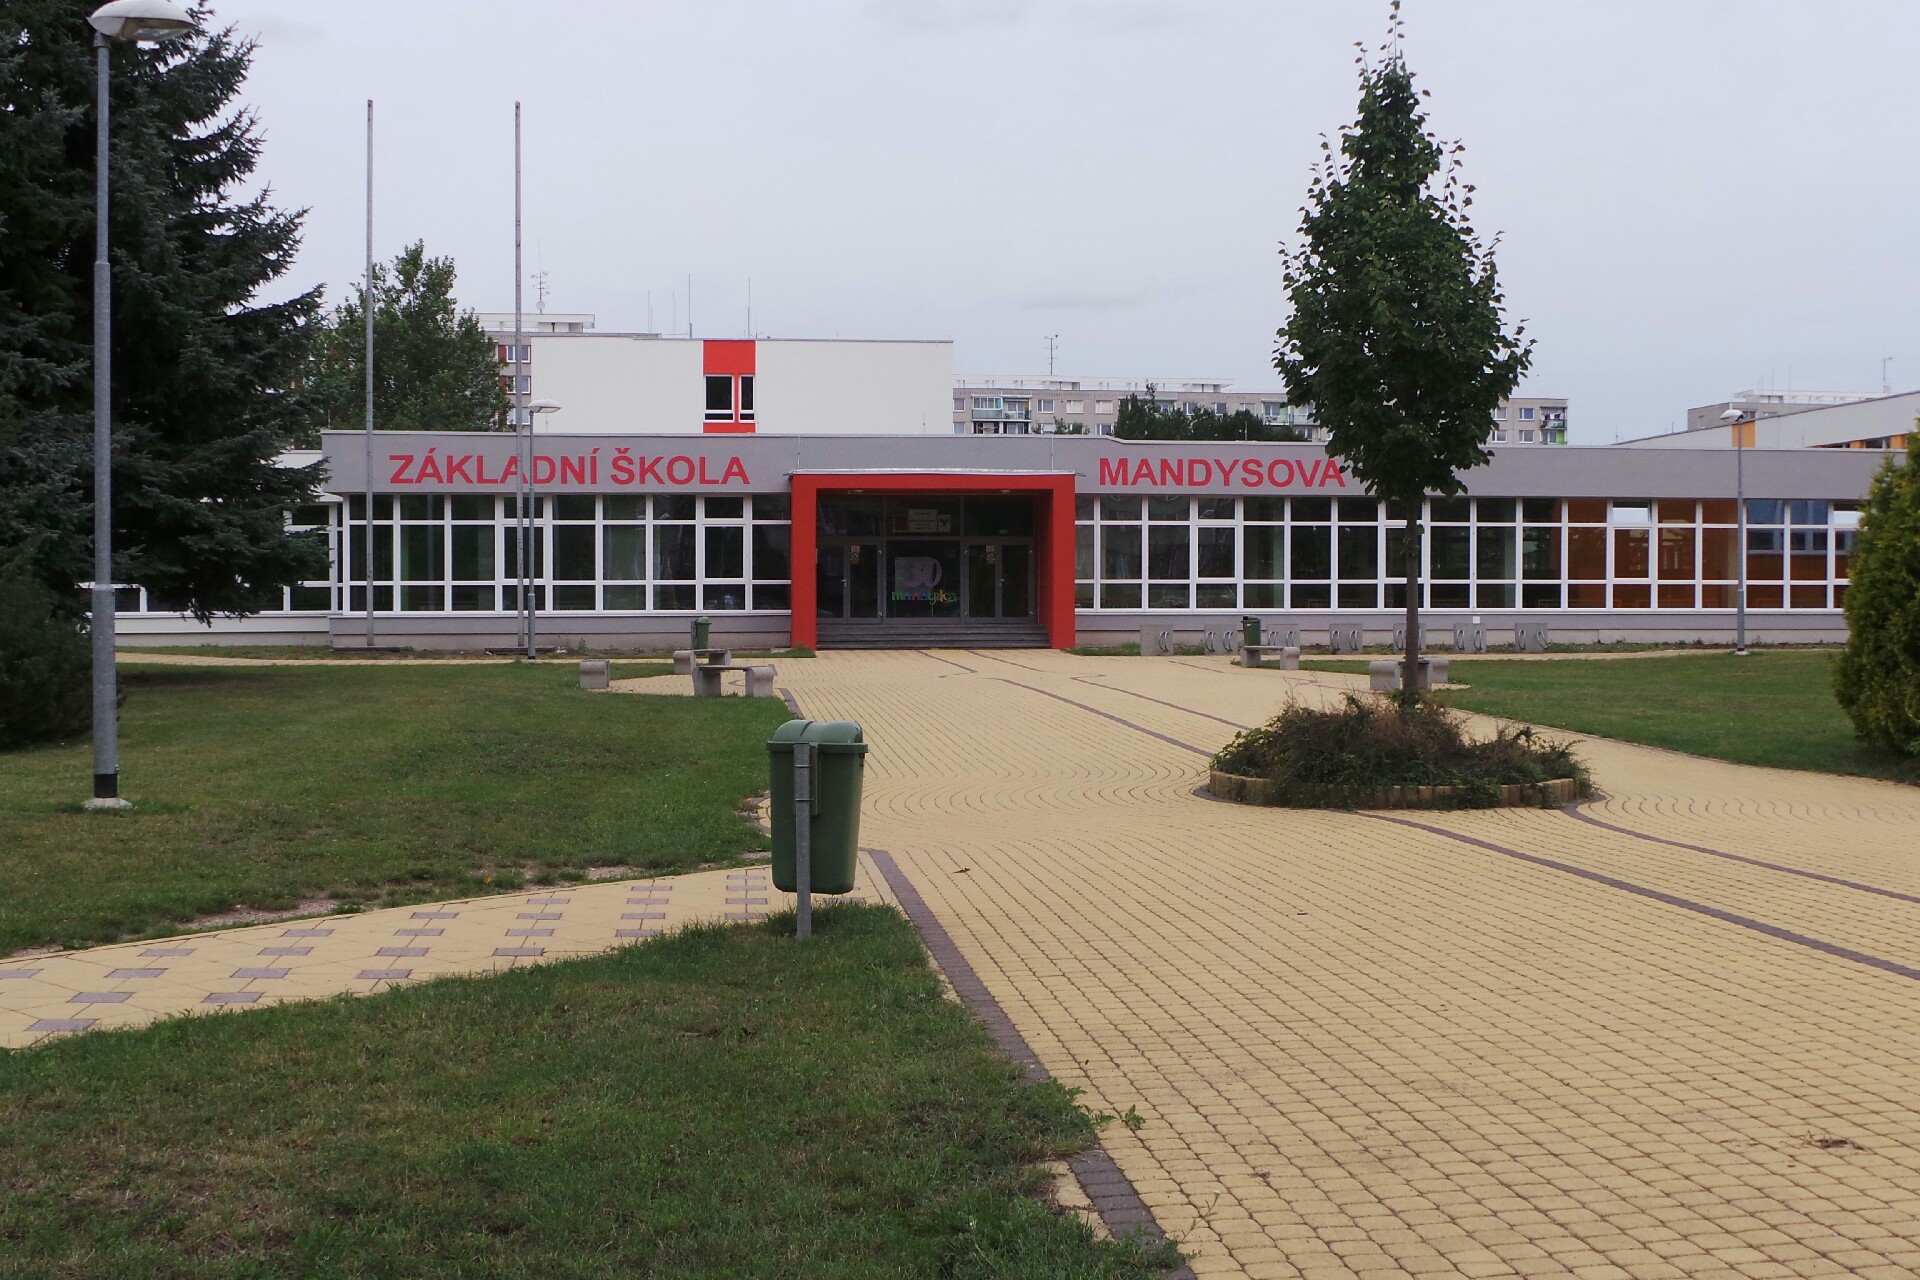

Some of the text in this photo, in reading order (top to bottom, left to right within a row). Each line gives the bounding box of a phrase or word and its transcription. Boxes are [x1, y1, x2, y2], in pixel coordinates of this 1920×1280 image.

[389, 447, 750, 485] ZÁKLADNÍ ŠKOLA
[1100, 458, 1345, 487] MANDYSOVA
